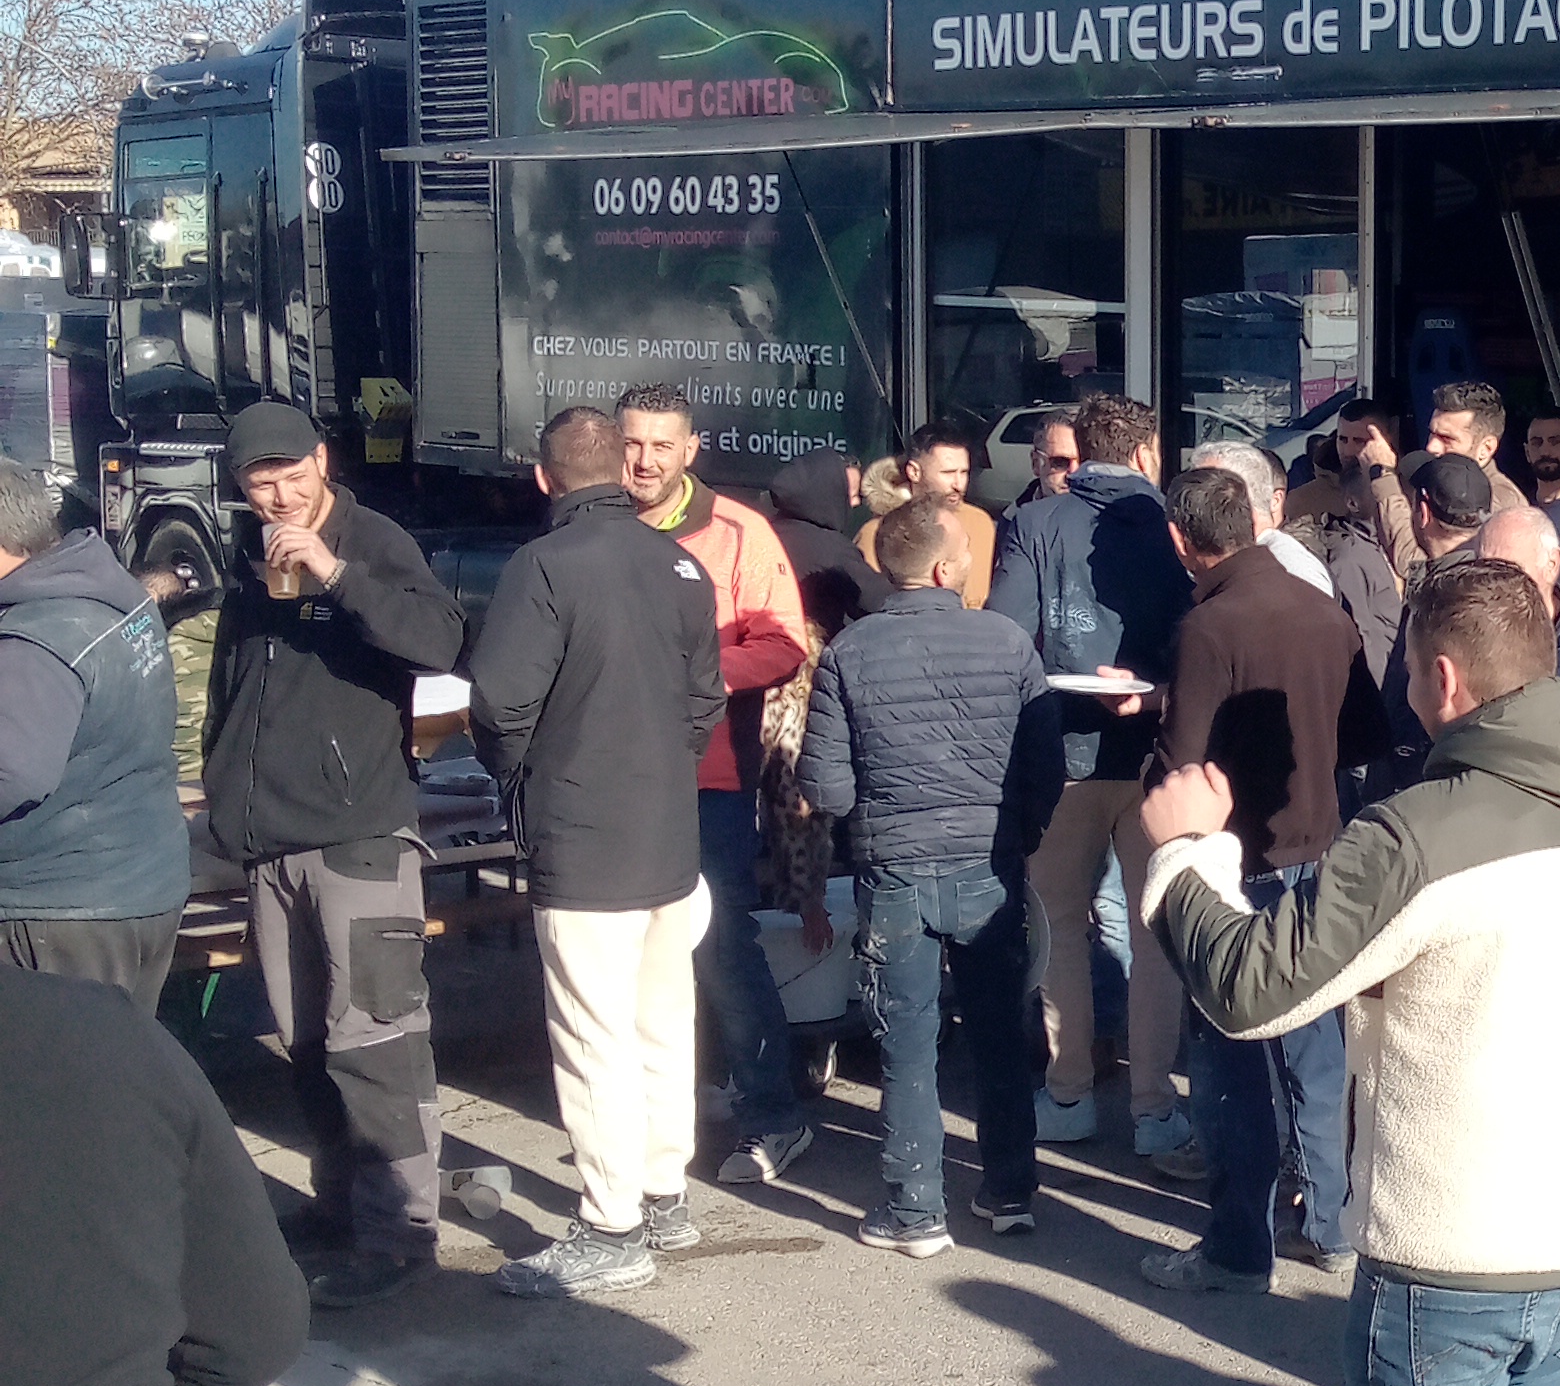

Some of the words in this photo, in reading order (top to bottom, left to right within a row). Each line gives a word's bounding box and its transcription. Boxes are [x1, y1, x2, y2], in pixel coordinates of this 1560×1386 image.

[579, 79, 694, 123] RACING
[700, 77, 795, 117] CENTER
[594, 177, 625, 215] 06
[631, 176, 663, 214] 09
[669, 175, 701, 214] 60
[707, 174, 740, 214] 43
[748, 173, 781, 213] 35
[533, 336, 575, 356] CHEZ
[638, 340, 719, 362] PARTOUT
[726, 341, 750, 362] EN
[757, 342, 832, 366] FRANCE
[840, 348, 845, 366] !
[536, 371, 627, 401] Surprenez
[752, 386, 798, 407] avec
[808, 387, 845, 411] une
[719, 426, 740, 452] et
